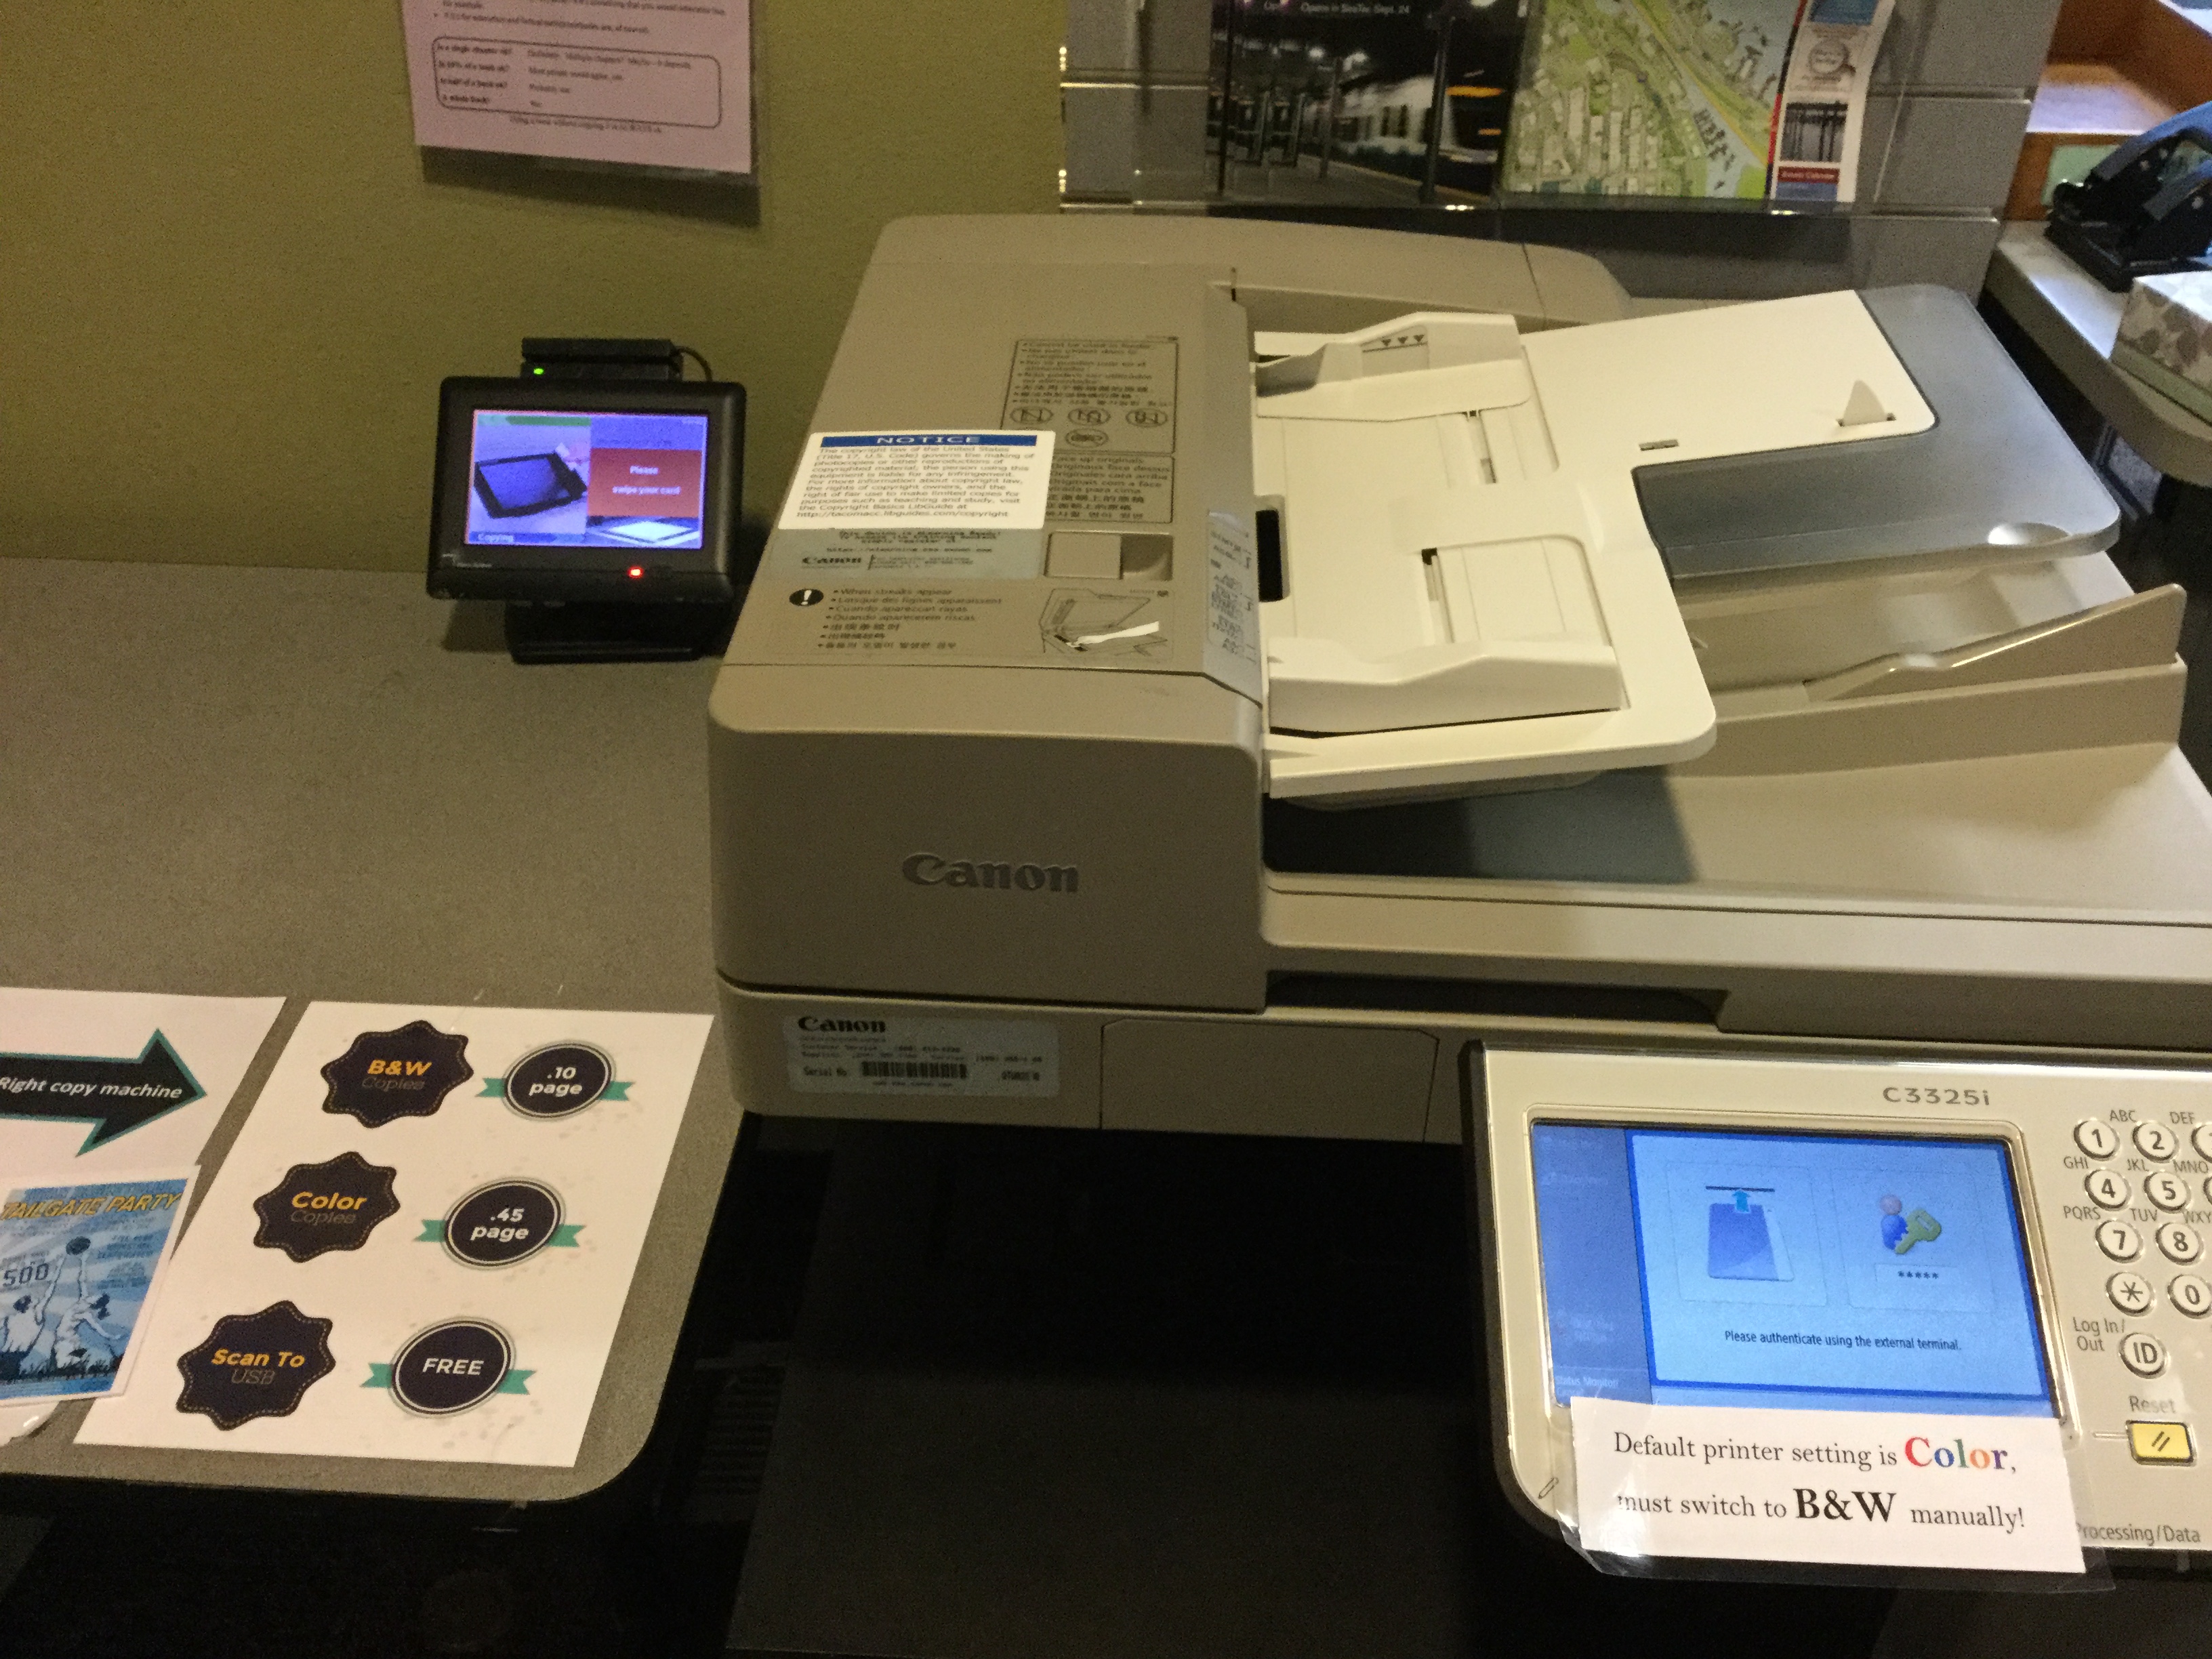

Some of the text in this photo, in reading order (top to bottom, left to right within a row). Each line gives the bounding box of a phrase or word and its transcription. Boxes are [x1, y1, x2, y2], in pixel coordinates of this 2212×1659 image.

[902, 853, 1079, 893] Canon
[798, 1017, 886, 1033] Canon
[367, 1059, 432, 1076] B&W
[546, 1066, 576, 1080] .10
[0, 1076, 182, 1099] Right copy machine
[361, 1076, 426, 1092] Copies
[529, 1082, 582, 1098] page
[1882, 1086, 1990, 1106] C3325i
[2110, 1109, 2138, 1122] ABC
[2169, 1111, 2194, 1124] DEF
[2091, 1129, 2102, 1148] 1
[2150, 1131, 2165, 1149] 2
[2063, 1156, 2089, 1169] GHI
[2127, 1159, 2149, 1172] JKL
[2173, 1160, 2209, 1173] MNO
[2102, 1179, 2116, 1198] 4
[2162, 1181, 2175, 1200] 5
[1, 1193, 182, 1220] TAILGATE PARTY
[291, 1191, 368, 1210] Color
[290, 1210, 357, 1227] Copies
[491, 1208, 525, 1223] .45
[2063, 1206, 2101, 1221] PQRS
[2129, 1208, 2157, 1221] TUV
[470, 1224, 529, 1243] page
[2113, 1229, 2126, 1250] 7
[2173, 1231, 2188, 1252] 8
[3, 1263, 49, 1287] 500
[2185, 1285, 2200, 1305] 0
[2073, 1317, 2100, 1336] Log
[1724, 1330, 1961, 1350] Please authenticate using the external terminal.
[2076, 1335, 2106, 1351] Out
[211, 1348, 305, 1368] Scan To
[2133, 1342, 2158, 1364] ID
[422, 1357, 485, 1376] FREE
[231, 1368, 274, 1385] USB
[2128, 1395, 2176, 1414] Reset
[1614, 1431, 2017, 1473] Default printer setting is Color,
[1618, 1488, 2024, 1534] must switch to B&W manually!
